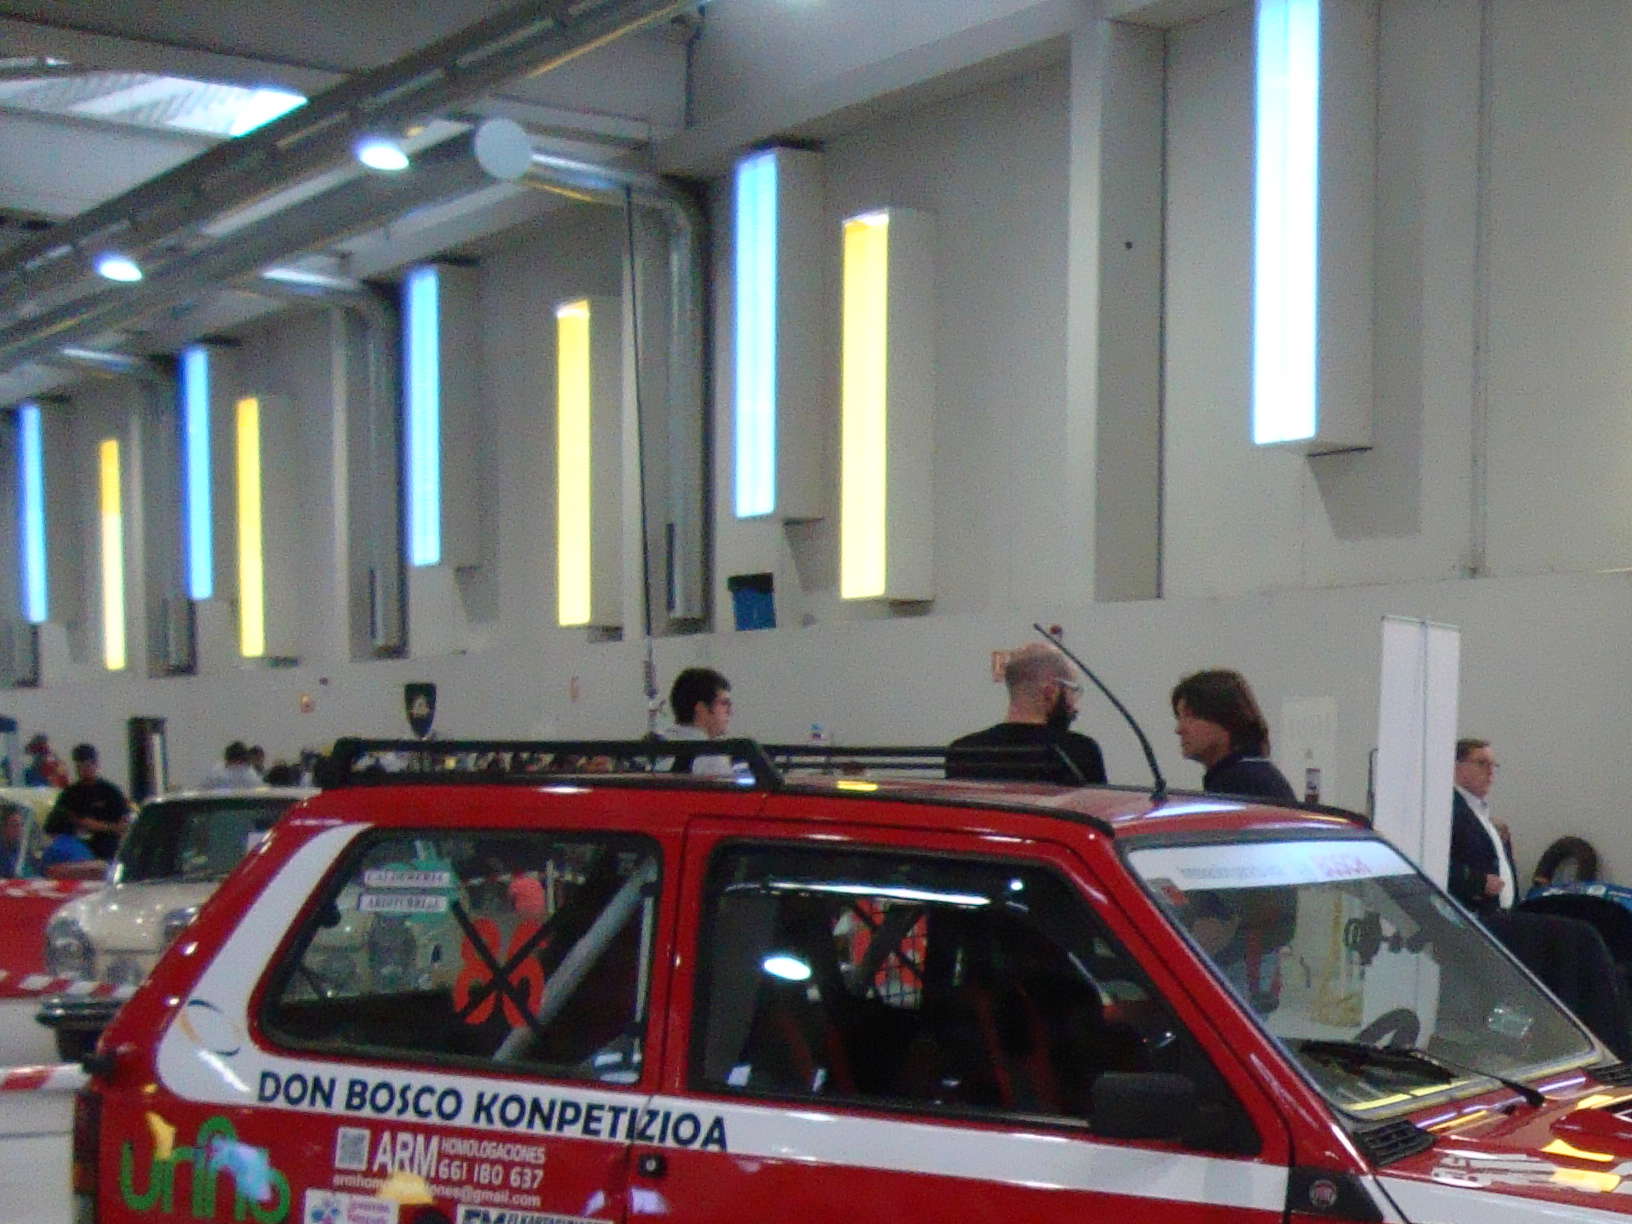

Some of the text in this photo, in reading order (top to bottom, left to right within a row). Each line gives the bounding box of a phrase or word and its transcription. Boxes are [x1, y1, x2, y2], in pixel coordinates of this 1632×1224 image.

[258, 1071, 728, 1151] DON BOSCO KONPETIZIOA
[372, 1130, 440, 1178] ARM
[441, 1136, 545, 1164] HOMOLOGACIONES
[438, 1159, 544, 1189] 661 180 637
